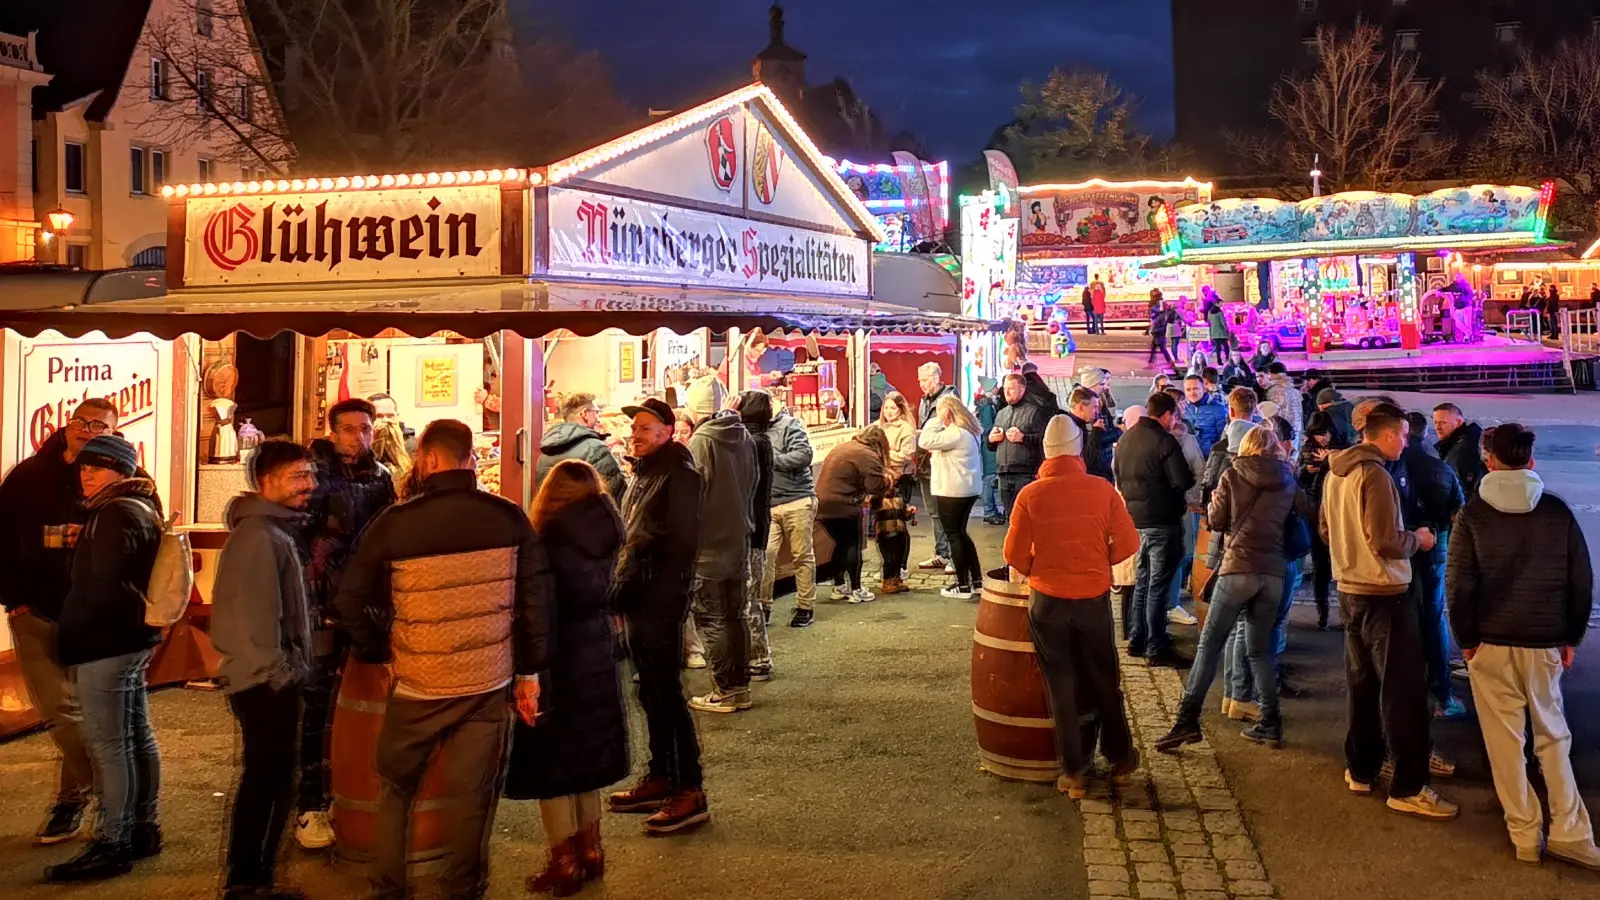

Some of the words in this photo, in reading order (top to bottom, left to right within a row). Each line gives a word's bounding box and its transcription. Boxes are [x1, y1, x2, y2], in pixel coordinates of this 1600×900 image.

[203, 195, 483, 272] Glühwein
[576, 199, 738, 278] Nürnberger
[741, 226, 857, 284] Spezialitäten
[48, 357, 113, 384] Prima
